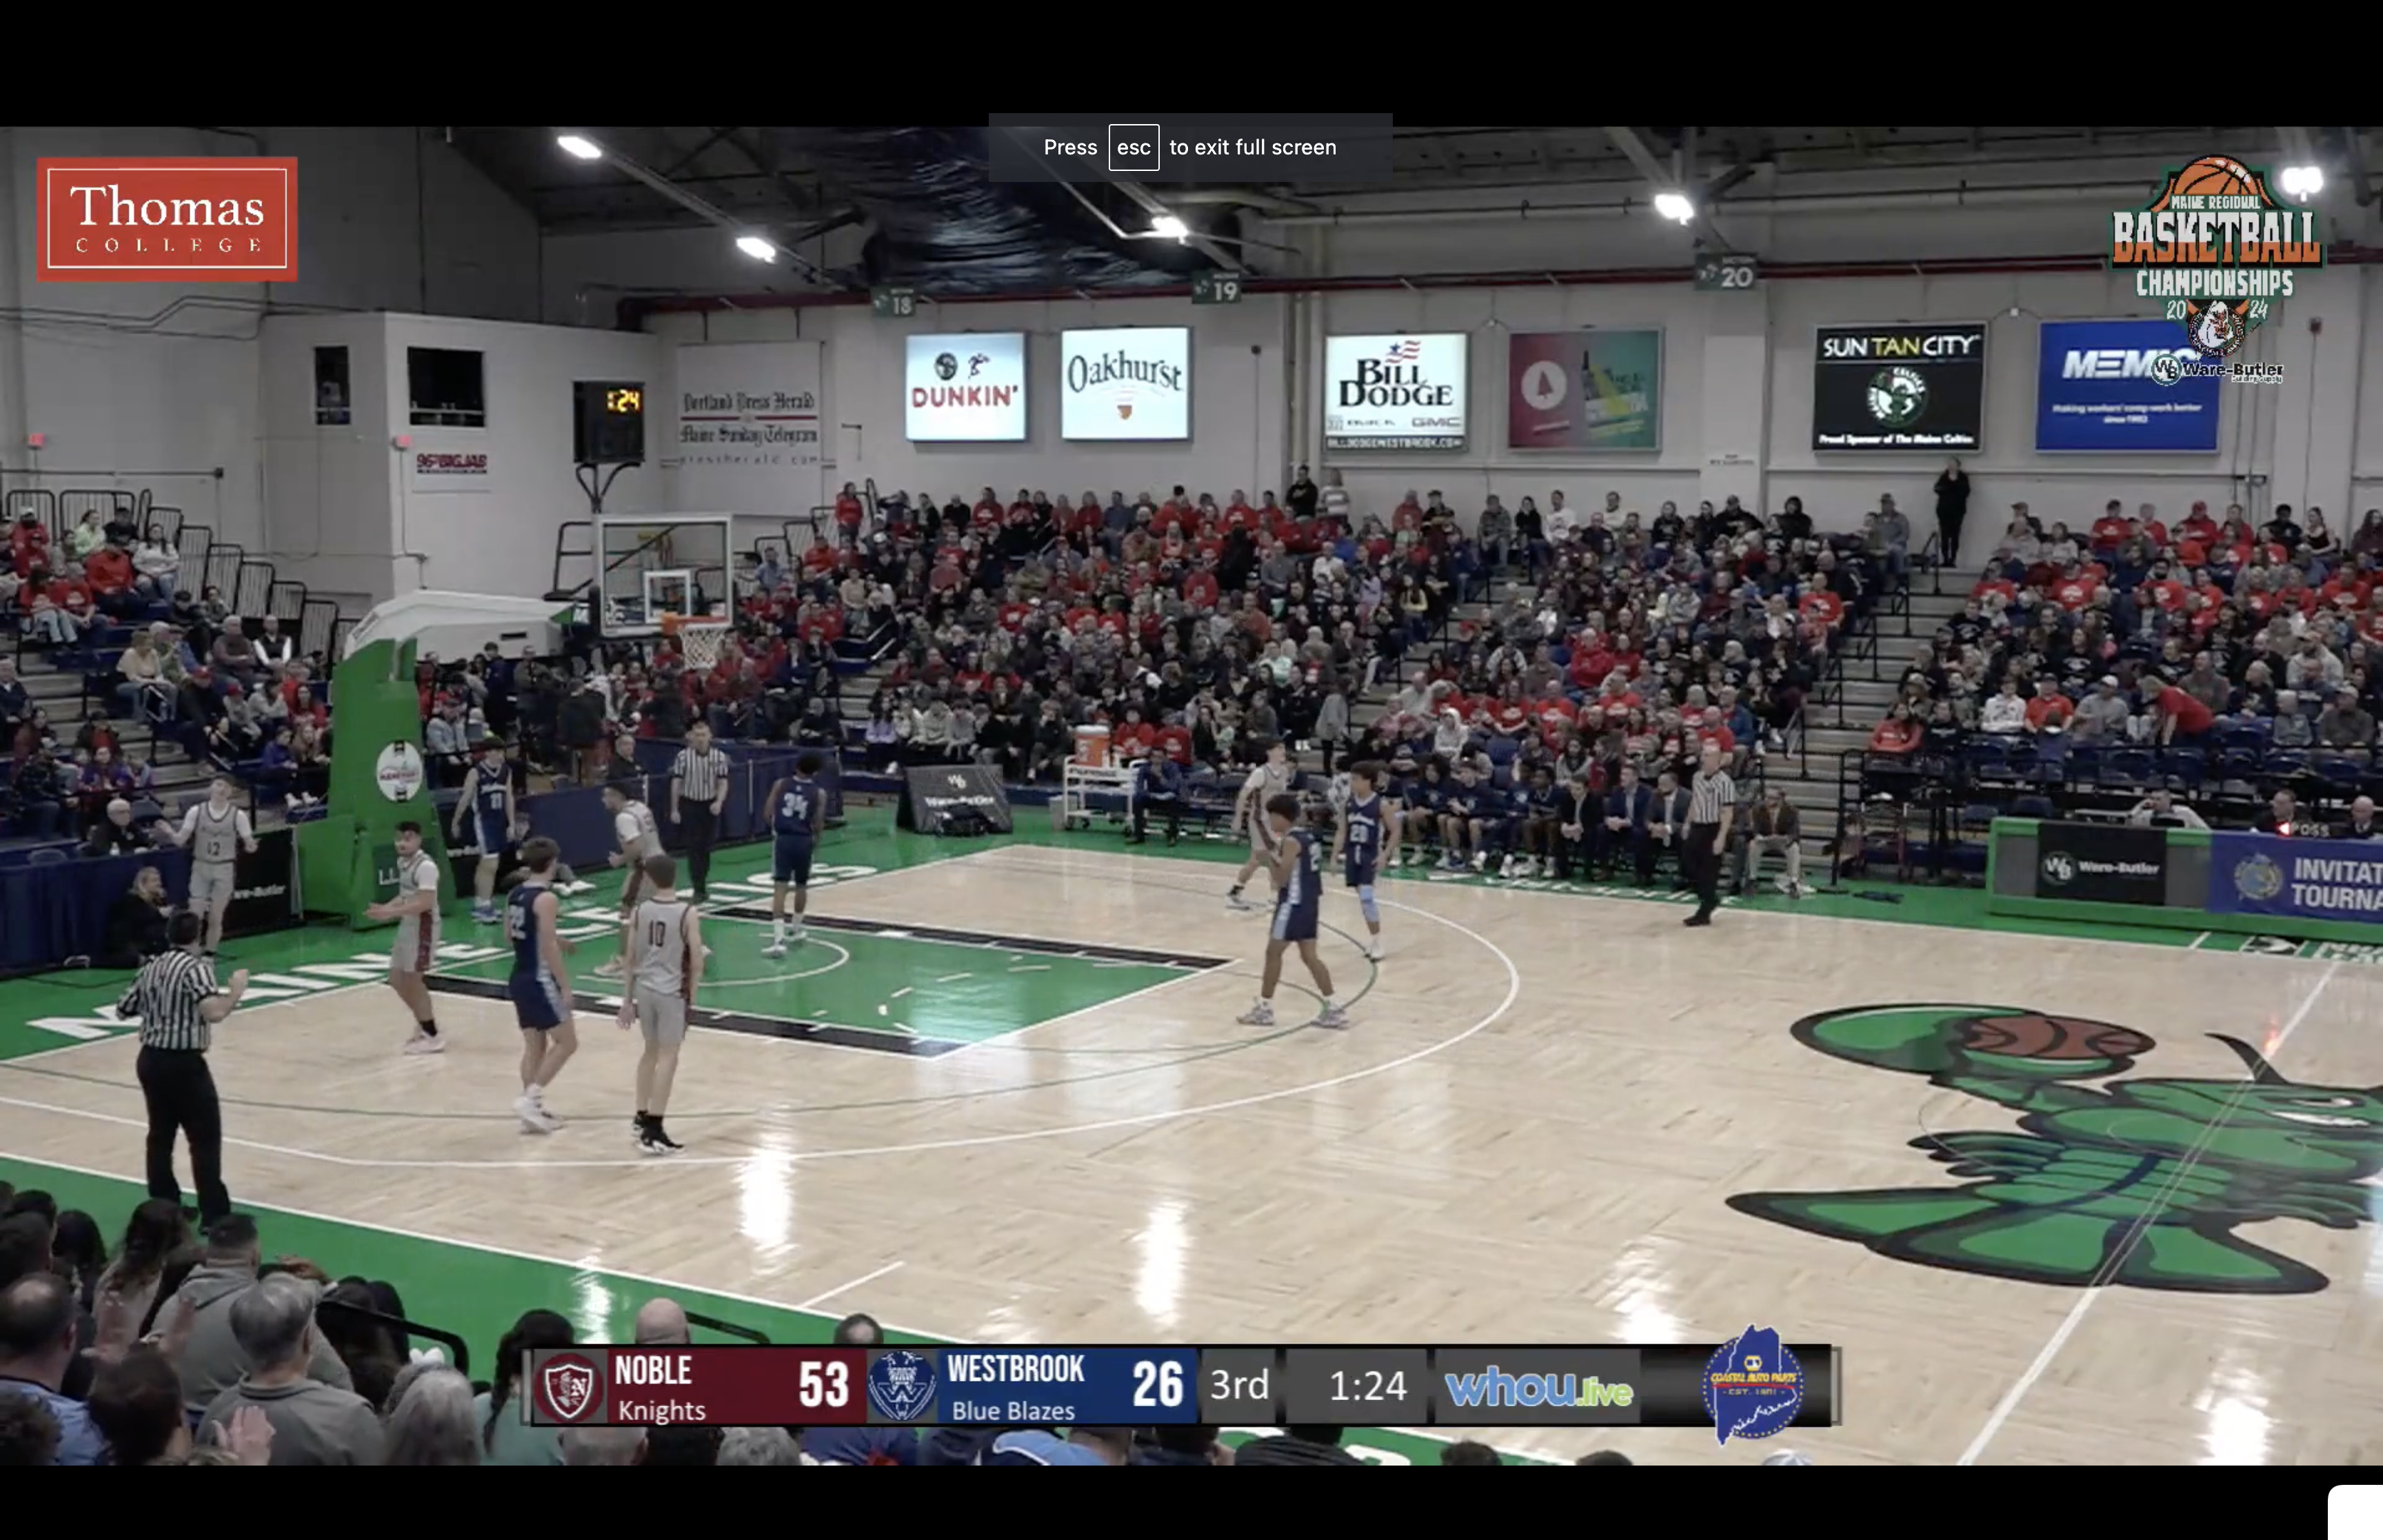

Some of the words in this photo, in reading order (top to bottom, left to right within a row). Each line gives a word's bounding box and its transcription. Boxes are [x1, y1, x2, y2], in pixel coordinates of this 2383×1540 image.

[1722, 267, 1753, 287] 20
[1214, 281, 1237, 301] 19
[893, 296, 912, 315] 18
[1824, 338, 1868, 357] SUN
[1871, 337, 1920, 356] TAN
[1922, 335, 1974, 356] CITY
[1068, 350, 1183, 393] Oakhurst
[1357, 358, 1427, 385] BILL
[2062, 349, 2198, 379] MEM
[912, 385, 1019, 408] DUNKIN'
[1338, 380, 1454, 407] DODGE
[1411, 417, 1461, 427] GMC
[649, 920, 666, 947] 10
